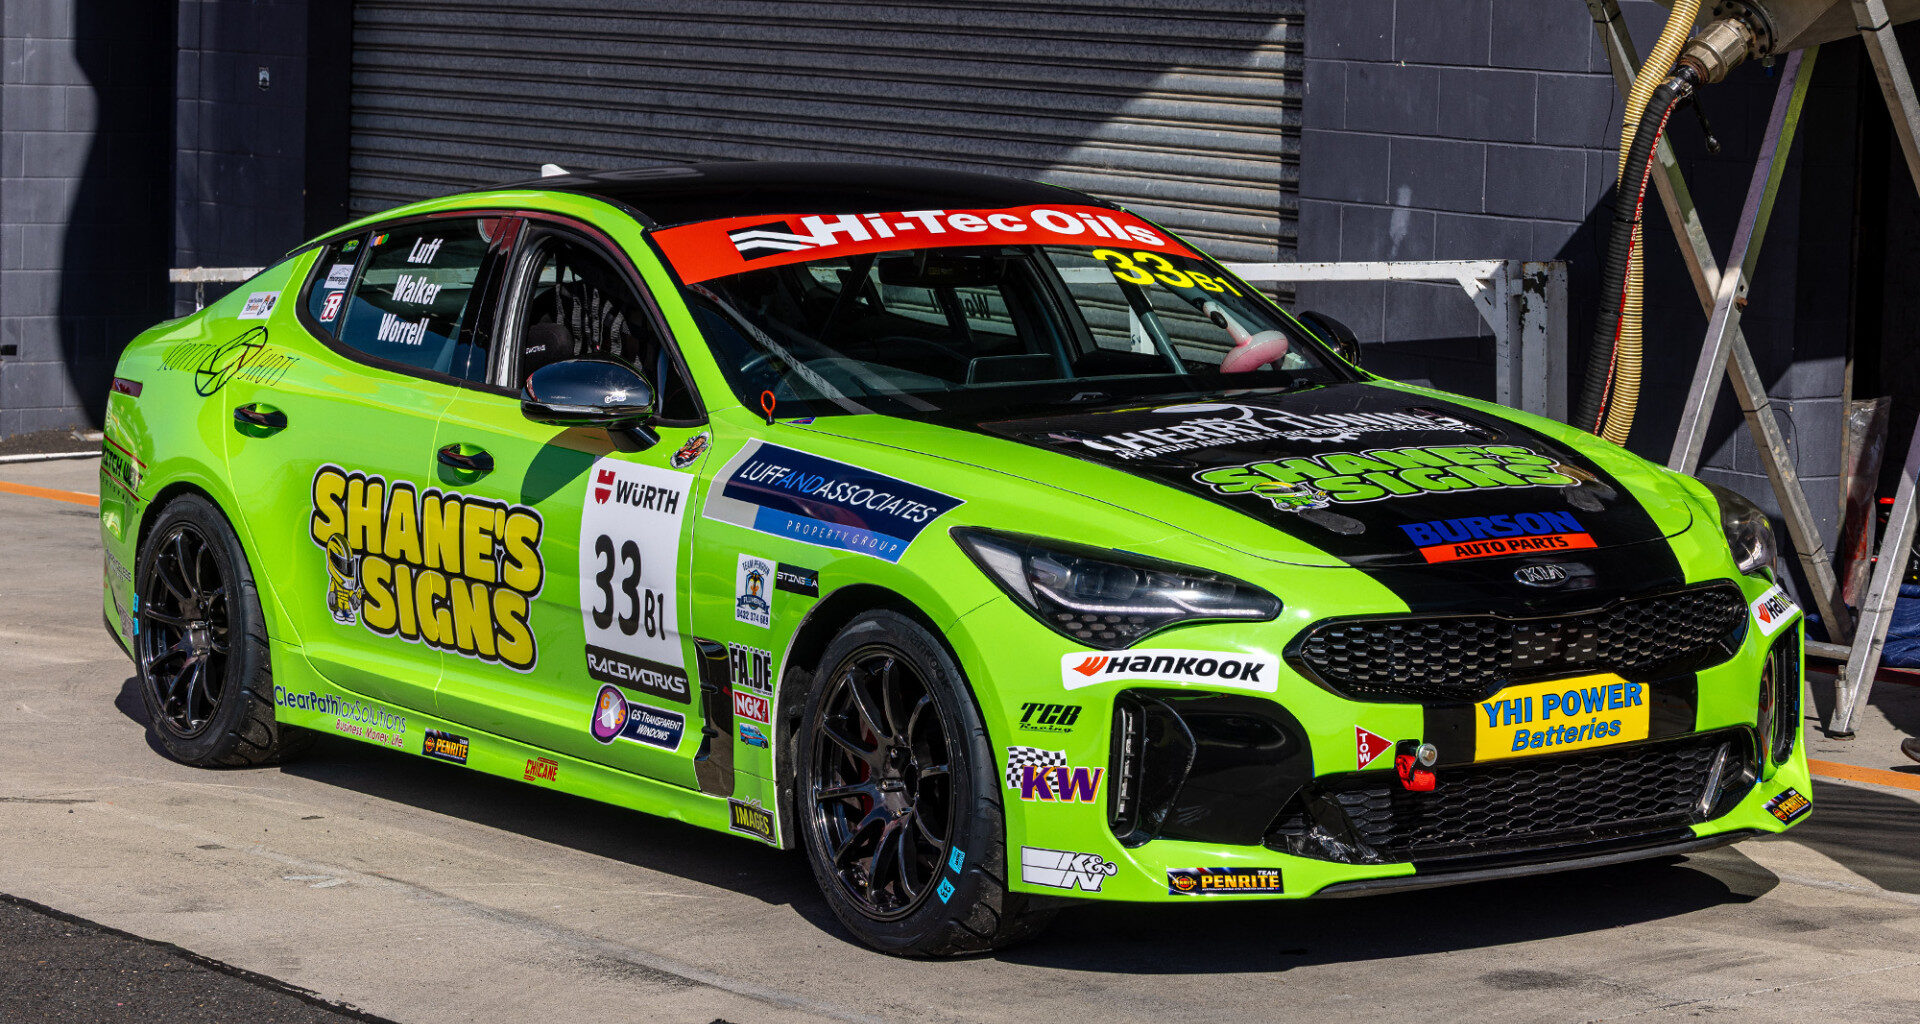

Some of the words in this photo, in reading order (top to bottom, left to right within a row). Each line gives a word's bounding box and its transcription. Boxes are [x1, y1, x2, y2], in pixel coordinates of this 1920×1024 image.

[802, 210, 1026, 247] Hi-Tec
[1030, 208, 1165, 247] Oils
[407, 237, 443, 264] Luff
[1093, 249, 1194, 288] 33
[1192, 271, 1244, 298] B1
[391, 275, 443, 305] Walker
[377, 313, 430, 346] Worrell
[1197, 437, 1236, 448] AND
[1234, 432, 1271, 444] KIA
[1198, 446, 1536, 493] SHANE'S
[1326, 462, 1580, 503] SIGNS
[312, 470, 541, 593] SHANE'S
[787, 519, 848, 542] PROPERTY
[851, 533, 898, 555] GROUP
[1398, 511, 1587, 547] BURSON
[1454, 539, 1507, 558] AUTO
[1508, 535, 1570, 554] PARTS
[592, 534, 642, 636] 33
[644, 588, 666, 641] B1
[1522, 566, 1563, 583] KIA
[360, 556, 534, 665] SIGNS
[586, 653, 685, 694] RACEWORKS
[1105, 655, 1266, 683] HANKOOK
[631, 709, 642, 721] GS
[642, 711, 682, 731] TRANSPARENT
[1482, 696, 1533, 728] YHI
[1542, 682, 1643, 721] POWER
[637, 723, 670, 741] WINDOWS
[1019, 722, 1073, 733] Racing
[1511, 717, 1621, 753] Batteries
[436, 739, 468, 758] PENRITE
[1359, 733, 1371, 763] TOW
[525, 759, 558, 782] CHICANE
[1020, 764, 1107, 804] KW
[735, 805, 769, 835] IMAGES
[1201, 875, 1281, 889] PENRITE
